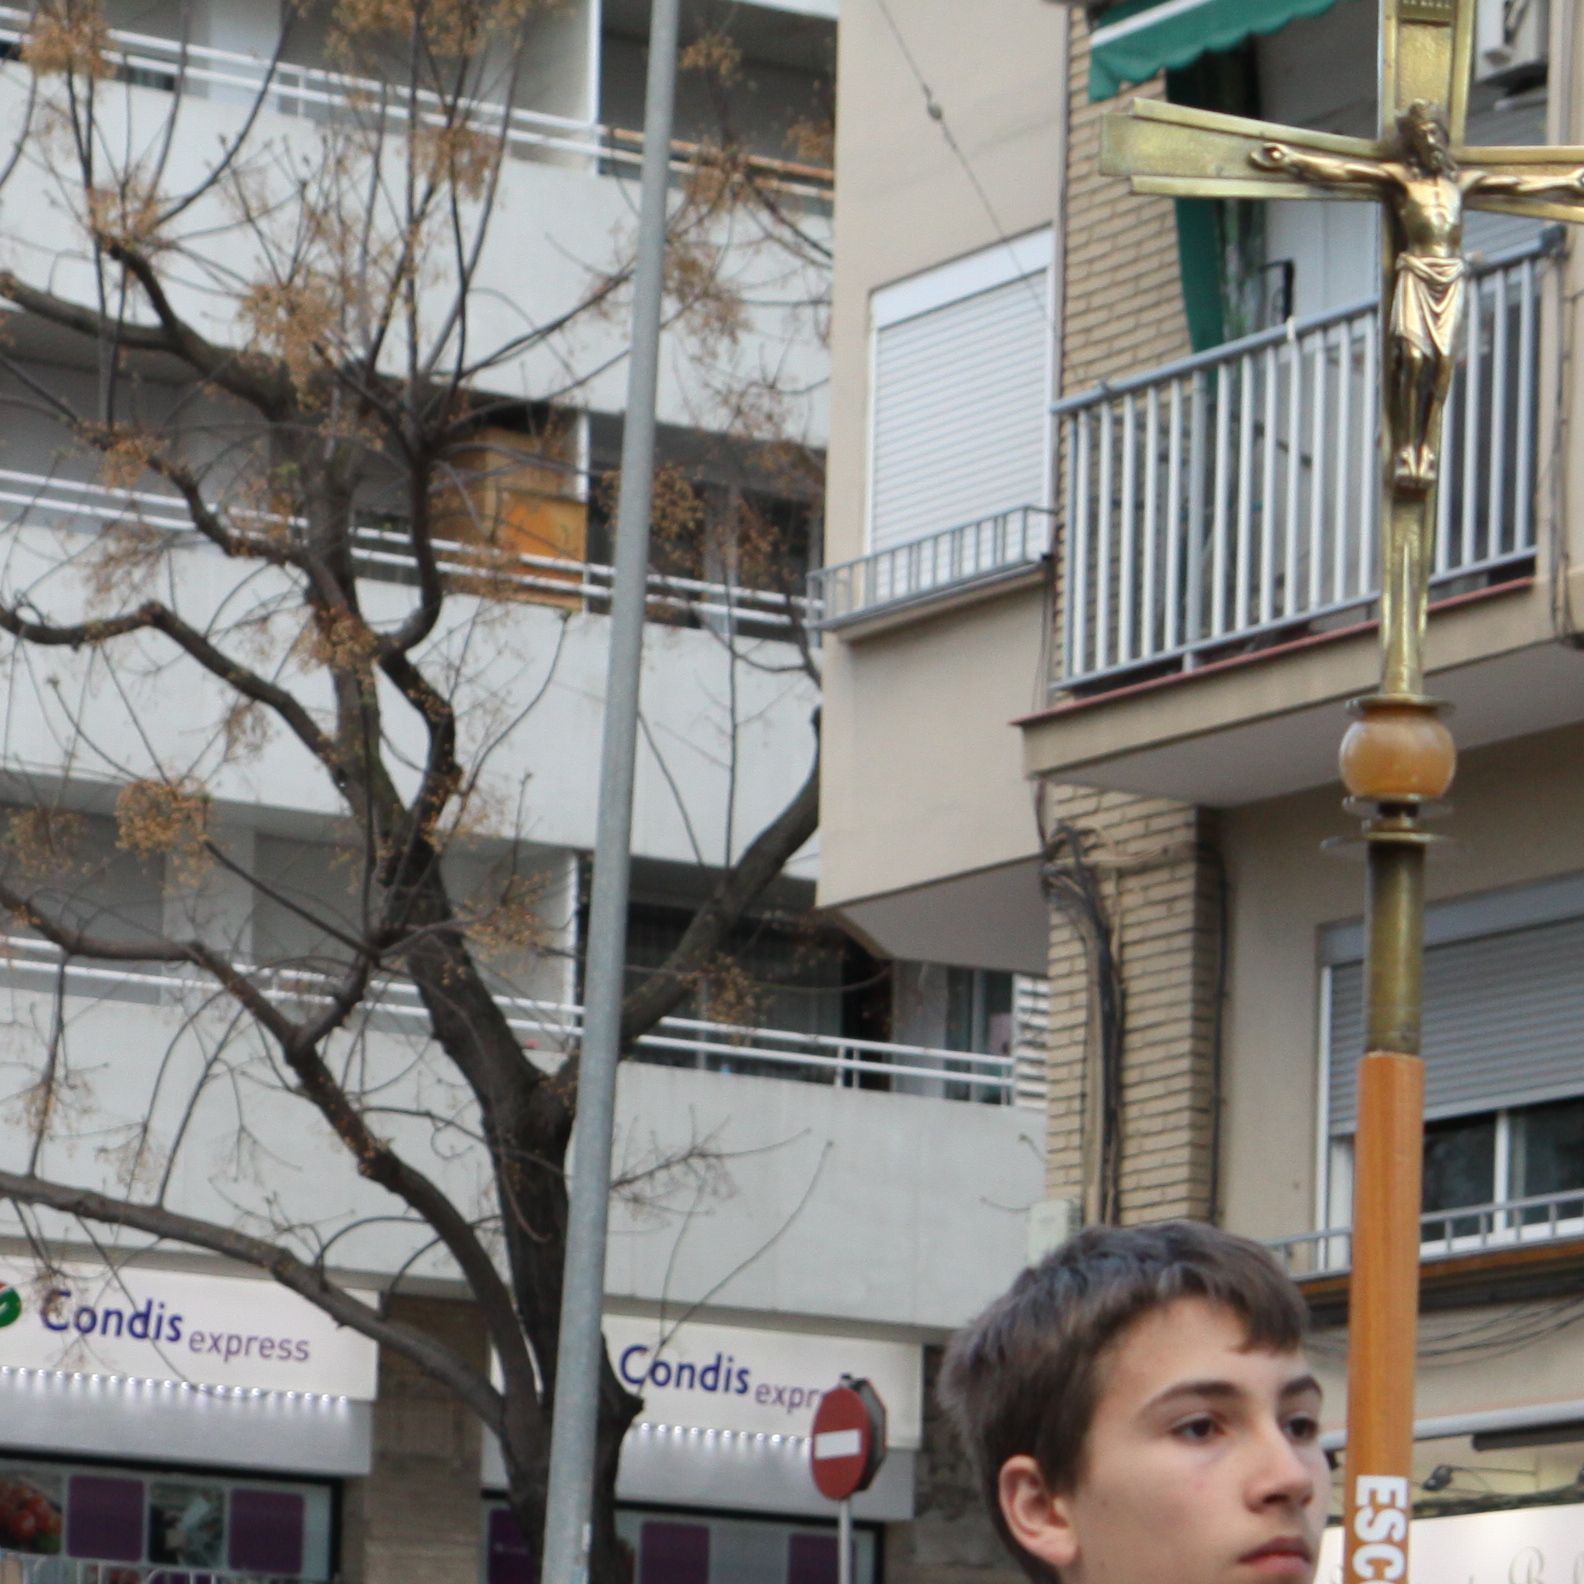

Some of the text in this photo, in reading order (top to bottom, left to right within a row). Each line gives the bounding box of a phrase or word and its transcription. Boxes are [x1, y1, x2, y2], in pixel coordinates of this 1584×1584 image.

[40, 1289, 310, 1363] Condis express
[620, 1344, 821, 1415] Condis expr
